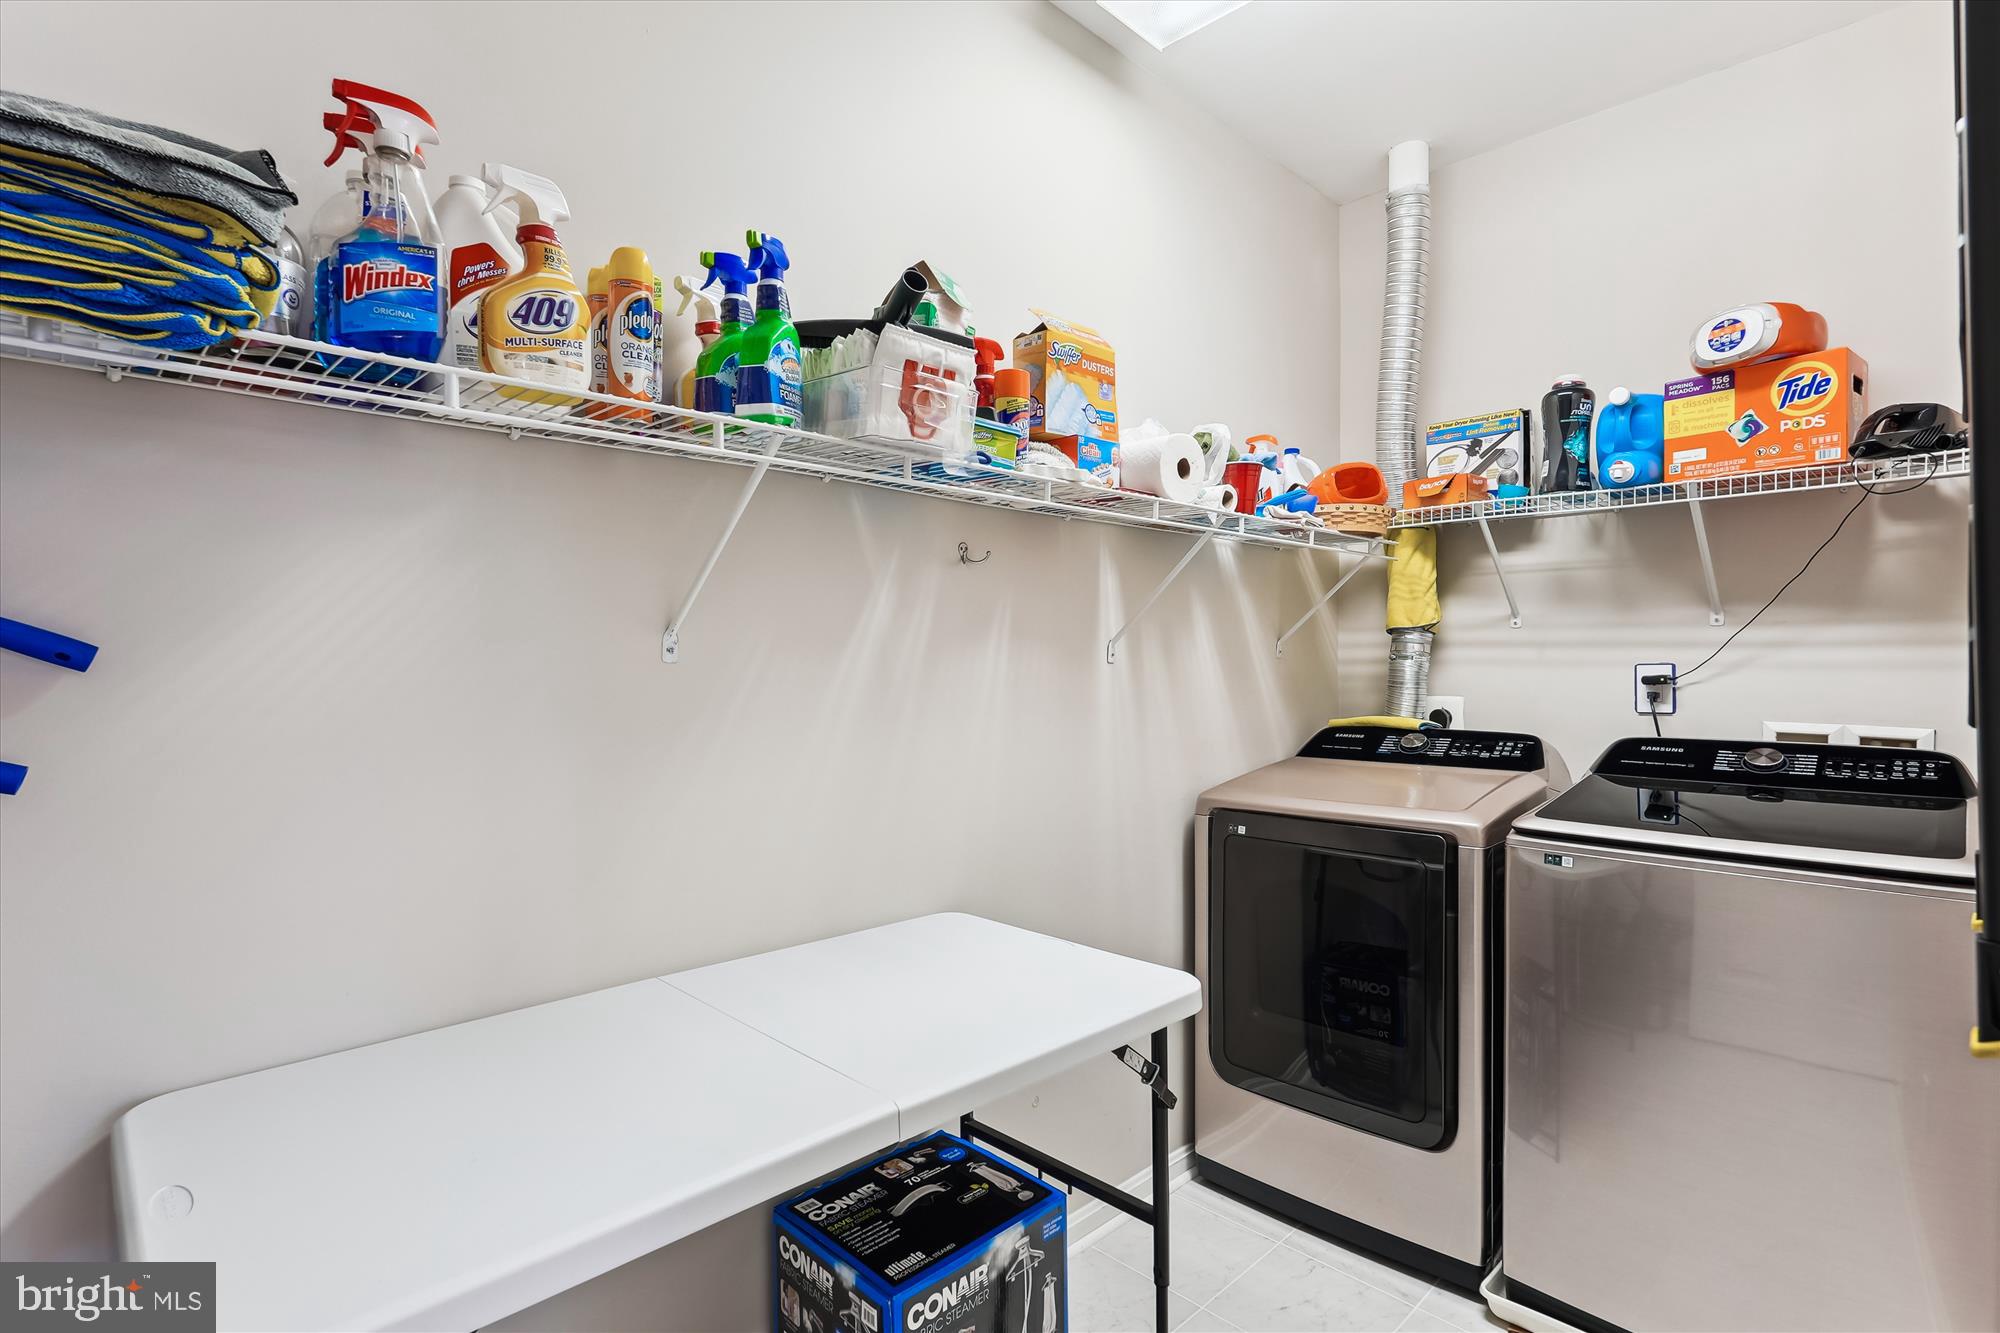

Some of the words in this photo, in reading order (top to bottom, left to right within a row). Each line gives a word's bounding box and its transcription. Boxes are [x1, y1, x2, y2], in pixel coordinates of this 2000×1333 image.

[464, 260, 495, 276] Powers
[477, 268, 506, 280] Messes
[343, 261, 435, 303] Windex
[373, 306, 416, 320] ORIGINAL
[511, 296, 575, 328] 409
[620, 310, 653, 336] pledg
[505, 338, 583, 350] MULTI-SURFACE
[621, 341, 653, 355] ORANG
[559, 350, 583, 358] CLEANER
[1048, 341, 1082, 366] Swiffer
[1082, 359, 1114, 377] DUSTERS
[1668, 381, 1694, 391] SPRING
[1711, 375, 1730, 385] 156
[1712, 383, 1730, 391] PACS
[1668, 386, 1701, 397] MEADOW
[1777, 371, 1832, 412] Tide
[1682, 394, 1730, 409] dissolves
[1454, 419, 1469, 427] Dryer
[1469, 416, 1490, 424] Running
[1466, 428, 1478, 436] Lint
[1507, 422, 1517, 430] Kit
[1780, 414, 1826, 433] PODS
[1081, 446, 1100, 457] Clean
[1640, 745, 1684, 753] SAMSUNG
[903, 1175, 921, 1186] 70
[808, 1182, 882, 1221] CONAIR
[819, 1209, 850, 1227] FABRIC
[849, 1190, 889, 1212] STEAMER
[827, 1217, 854, 1232] SAVE
[779, 1235, 835, 1300] CONAIR
[884, 1250, 926, 1277] ultimate
[802, 1281, 834, 1313] STEAMER
[907, 1262, 990, 1331] CONAIR
[945, 1288, 990, 1325] STEAMER
